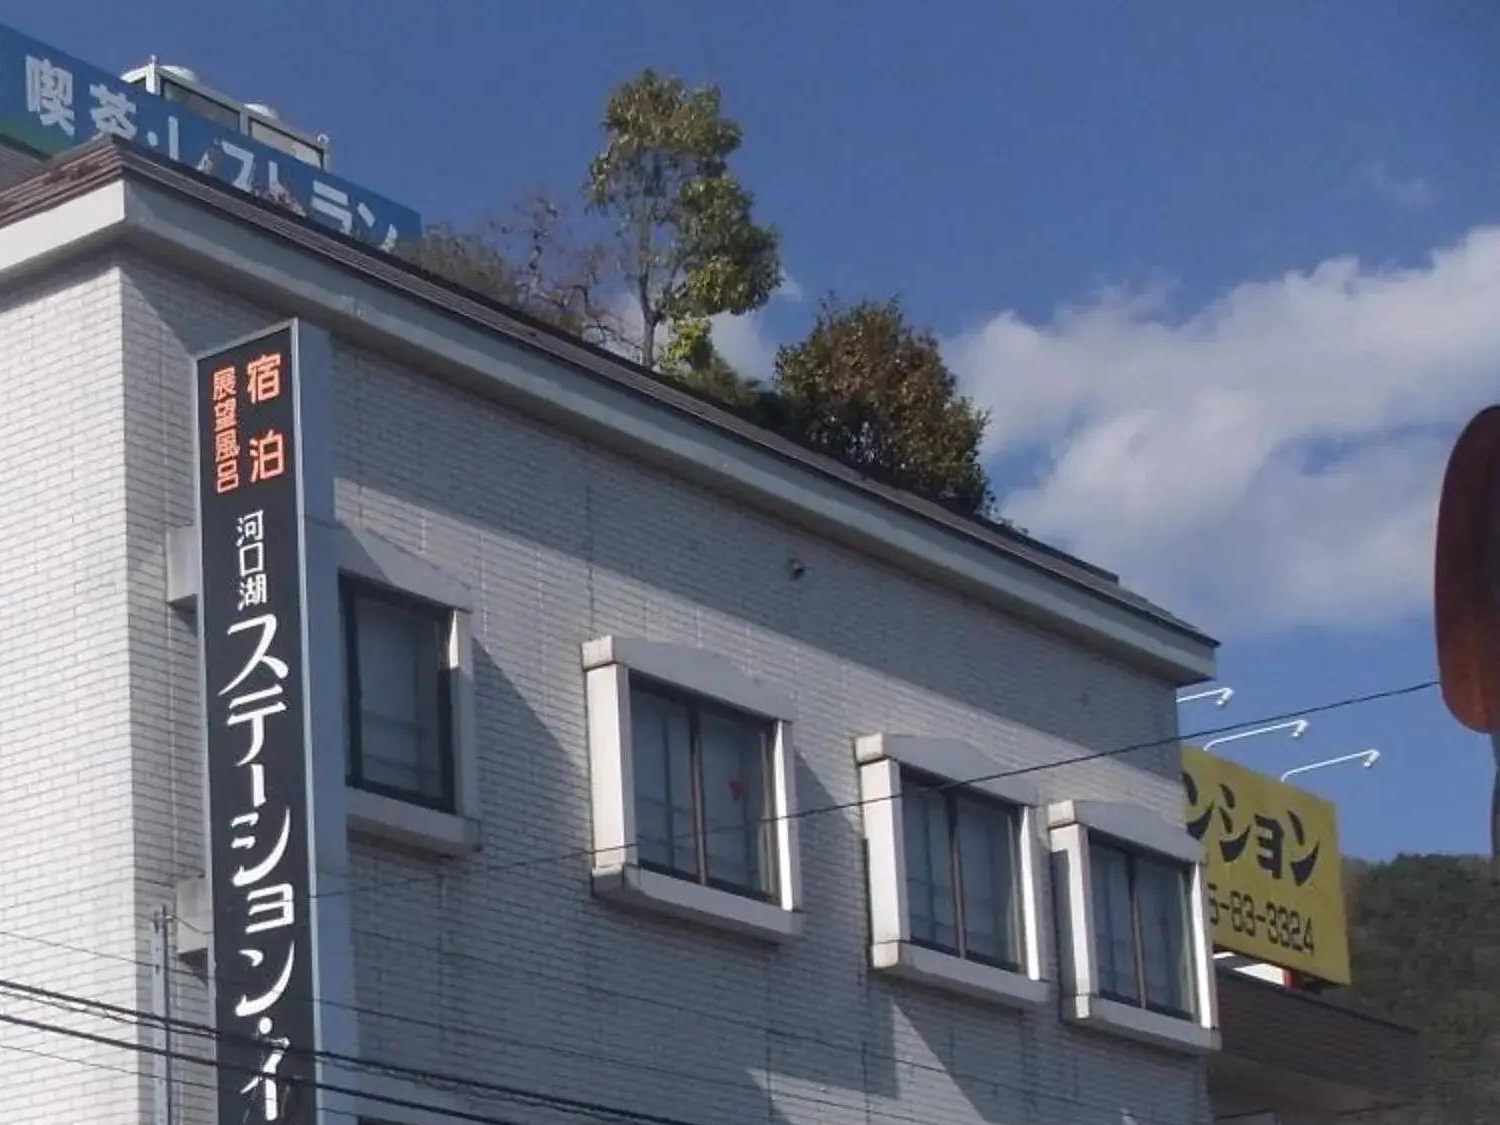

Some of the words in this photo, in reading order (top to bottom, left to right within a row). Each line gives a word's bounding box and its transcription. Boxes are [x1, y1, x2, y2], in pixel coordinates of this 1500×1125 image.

[212, 365, 240, 494] 展望風呂
[246, 352, 286, 483] 宿泊
[236, 509, 267, 612] 河口湖
